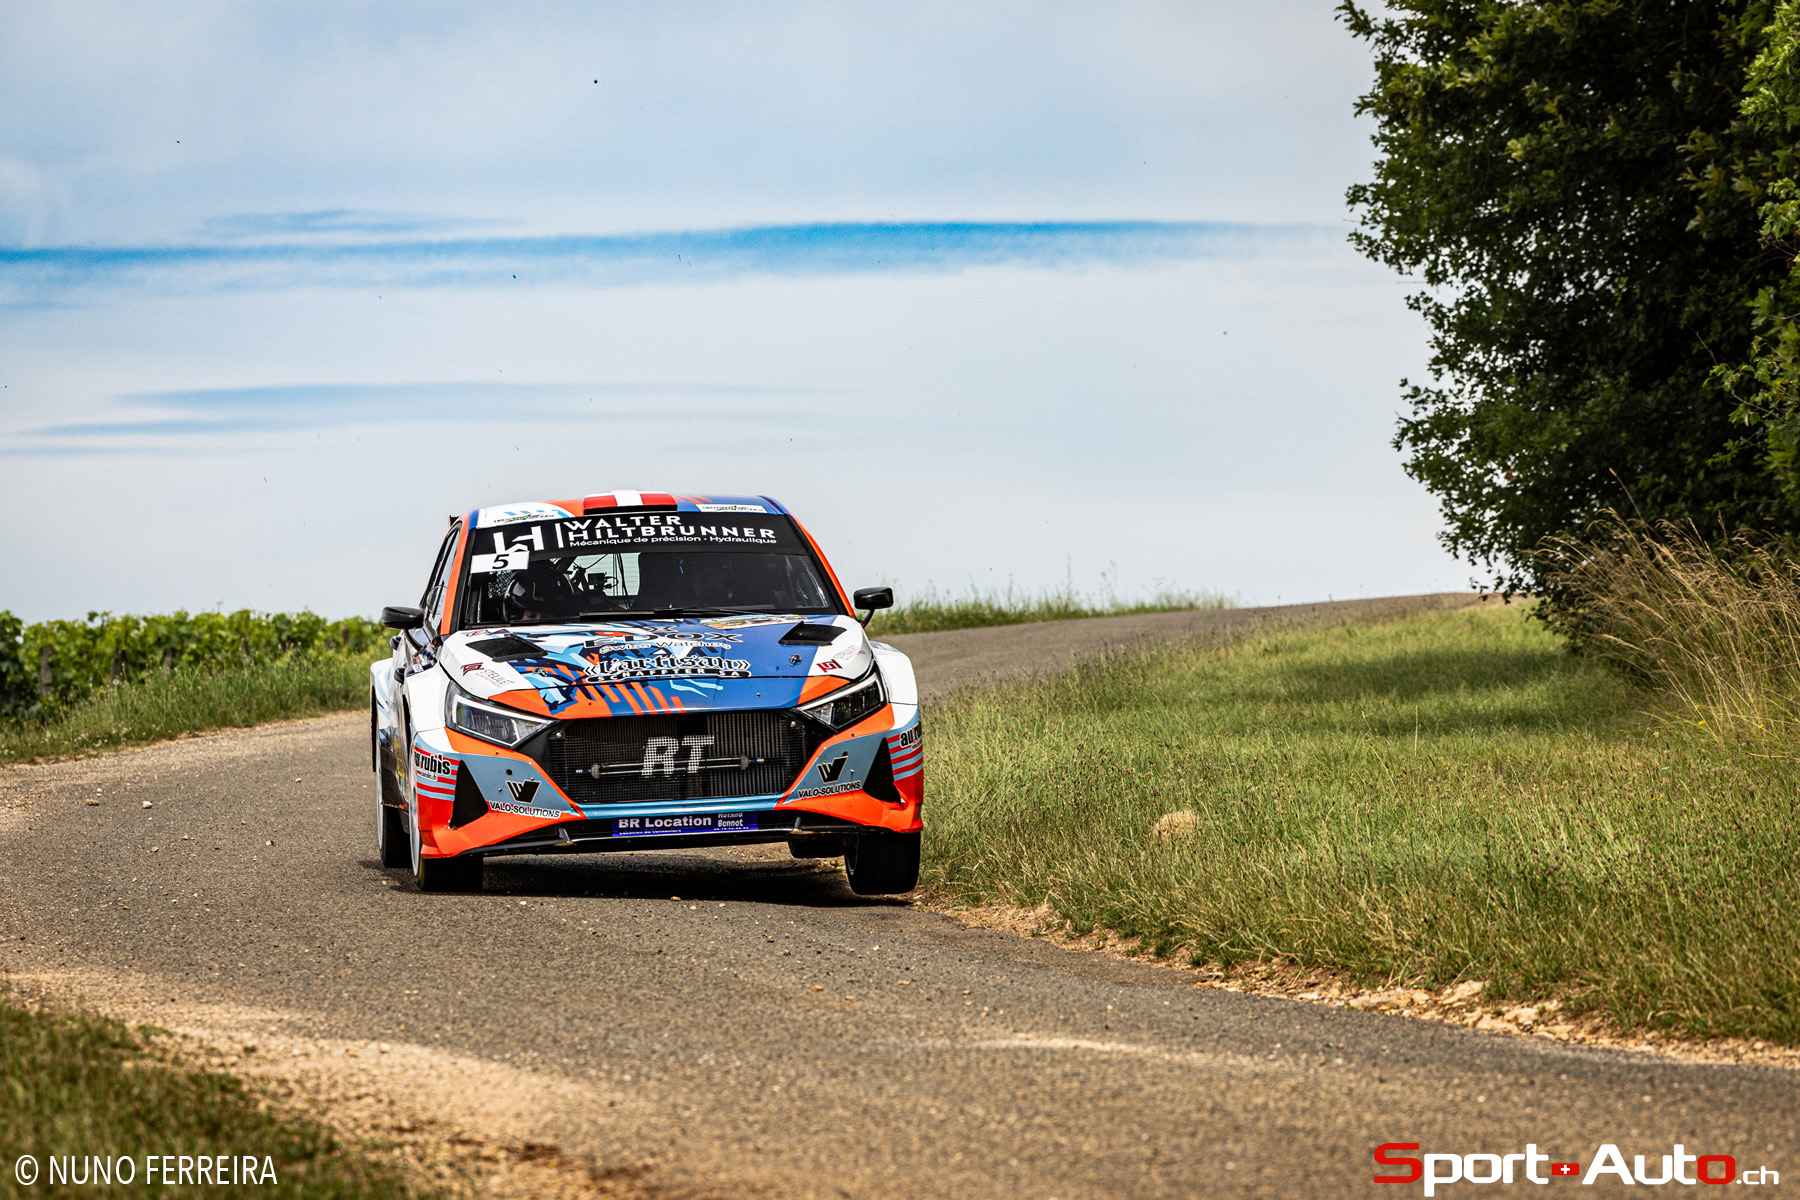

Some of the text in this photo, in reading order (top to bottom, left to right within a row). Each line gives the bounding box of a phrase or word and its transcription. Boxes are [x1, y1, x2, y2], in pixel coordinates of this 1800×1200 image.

[563, 515, 682, 530] WALTER
[568, 525, 776, 541] HILTBRUNNER
[569, 535, 777, 547] Mécanique de précision Hydraulique
[491, 553, 510, 570] 5
[583, 632, 744, 649] EDOX
[599, 640, 732, 654] Swiss Watches
[597, 667, 740, 681] SCHAFFTER SA
[641, 735, 715, 776] RT
[421, 754, 451, 775] rubis
[798, 780, 862, 798] VALO-SOLUTIONS
[489, 801, 561, 819] VALO-SOLUTIONS
[618, 815, 712, 829] BR Location
[717, 818, 744, 828] Bonnot
